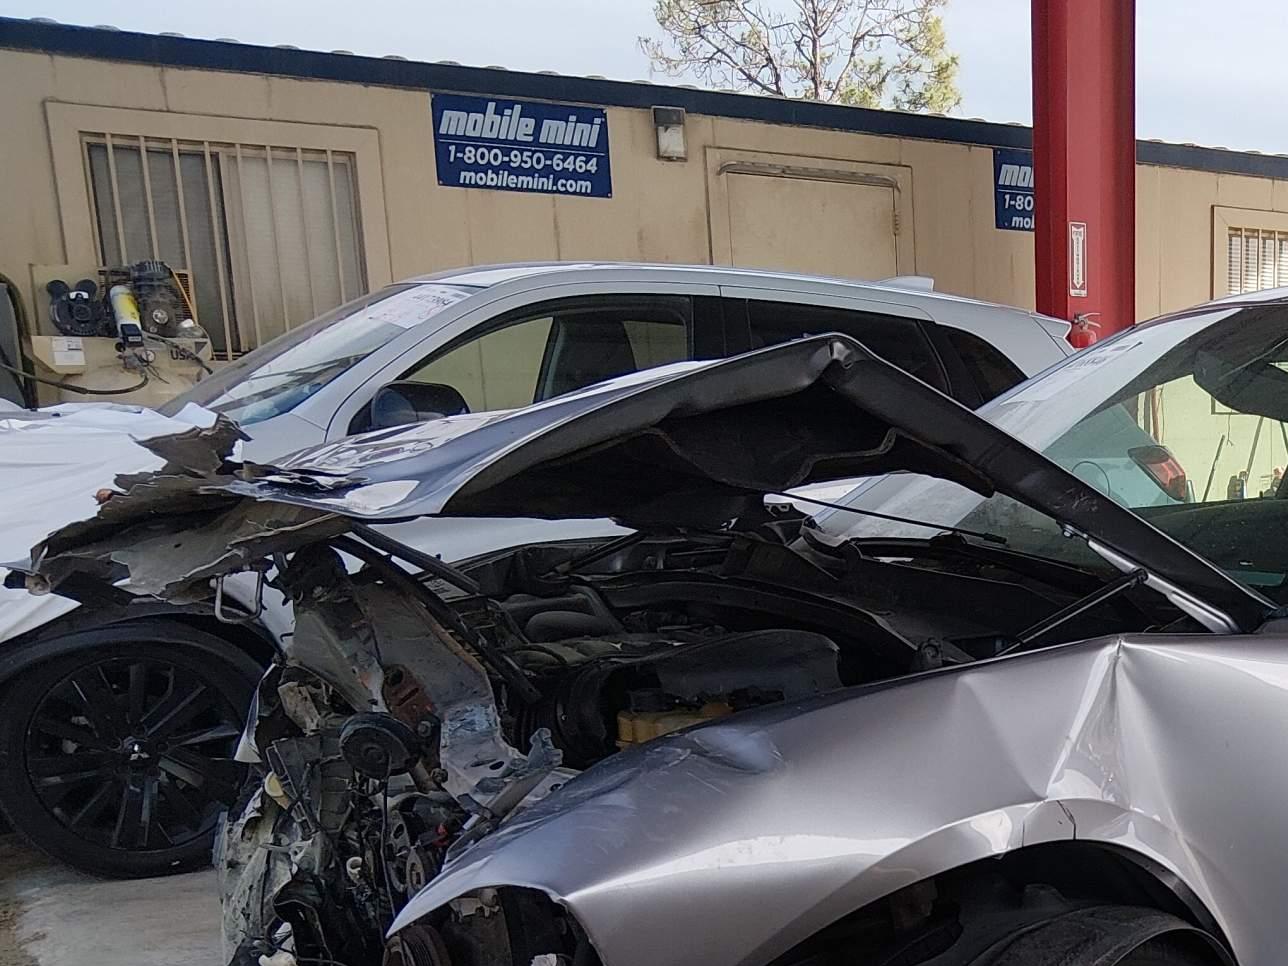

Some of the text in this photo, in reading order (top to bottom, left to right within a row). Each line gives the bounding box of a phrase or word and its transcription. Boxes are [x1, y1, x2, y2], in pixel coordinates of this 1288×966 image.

[439, 101, 602, 148] mobile mini
[448, 144, 598, 174] 1-800-950-6464
[459, 170, 592, 194] mobilemini.com
[998, 163, 1034, 188] mo
[1011, 214, 1035, 229] mo
